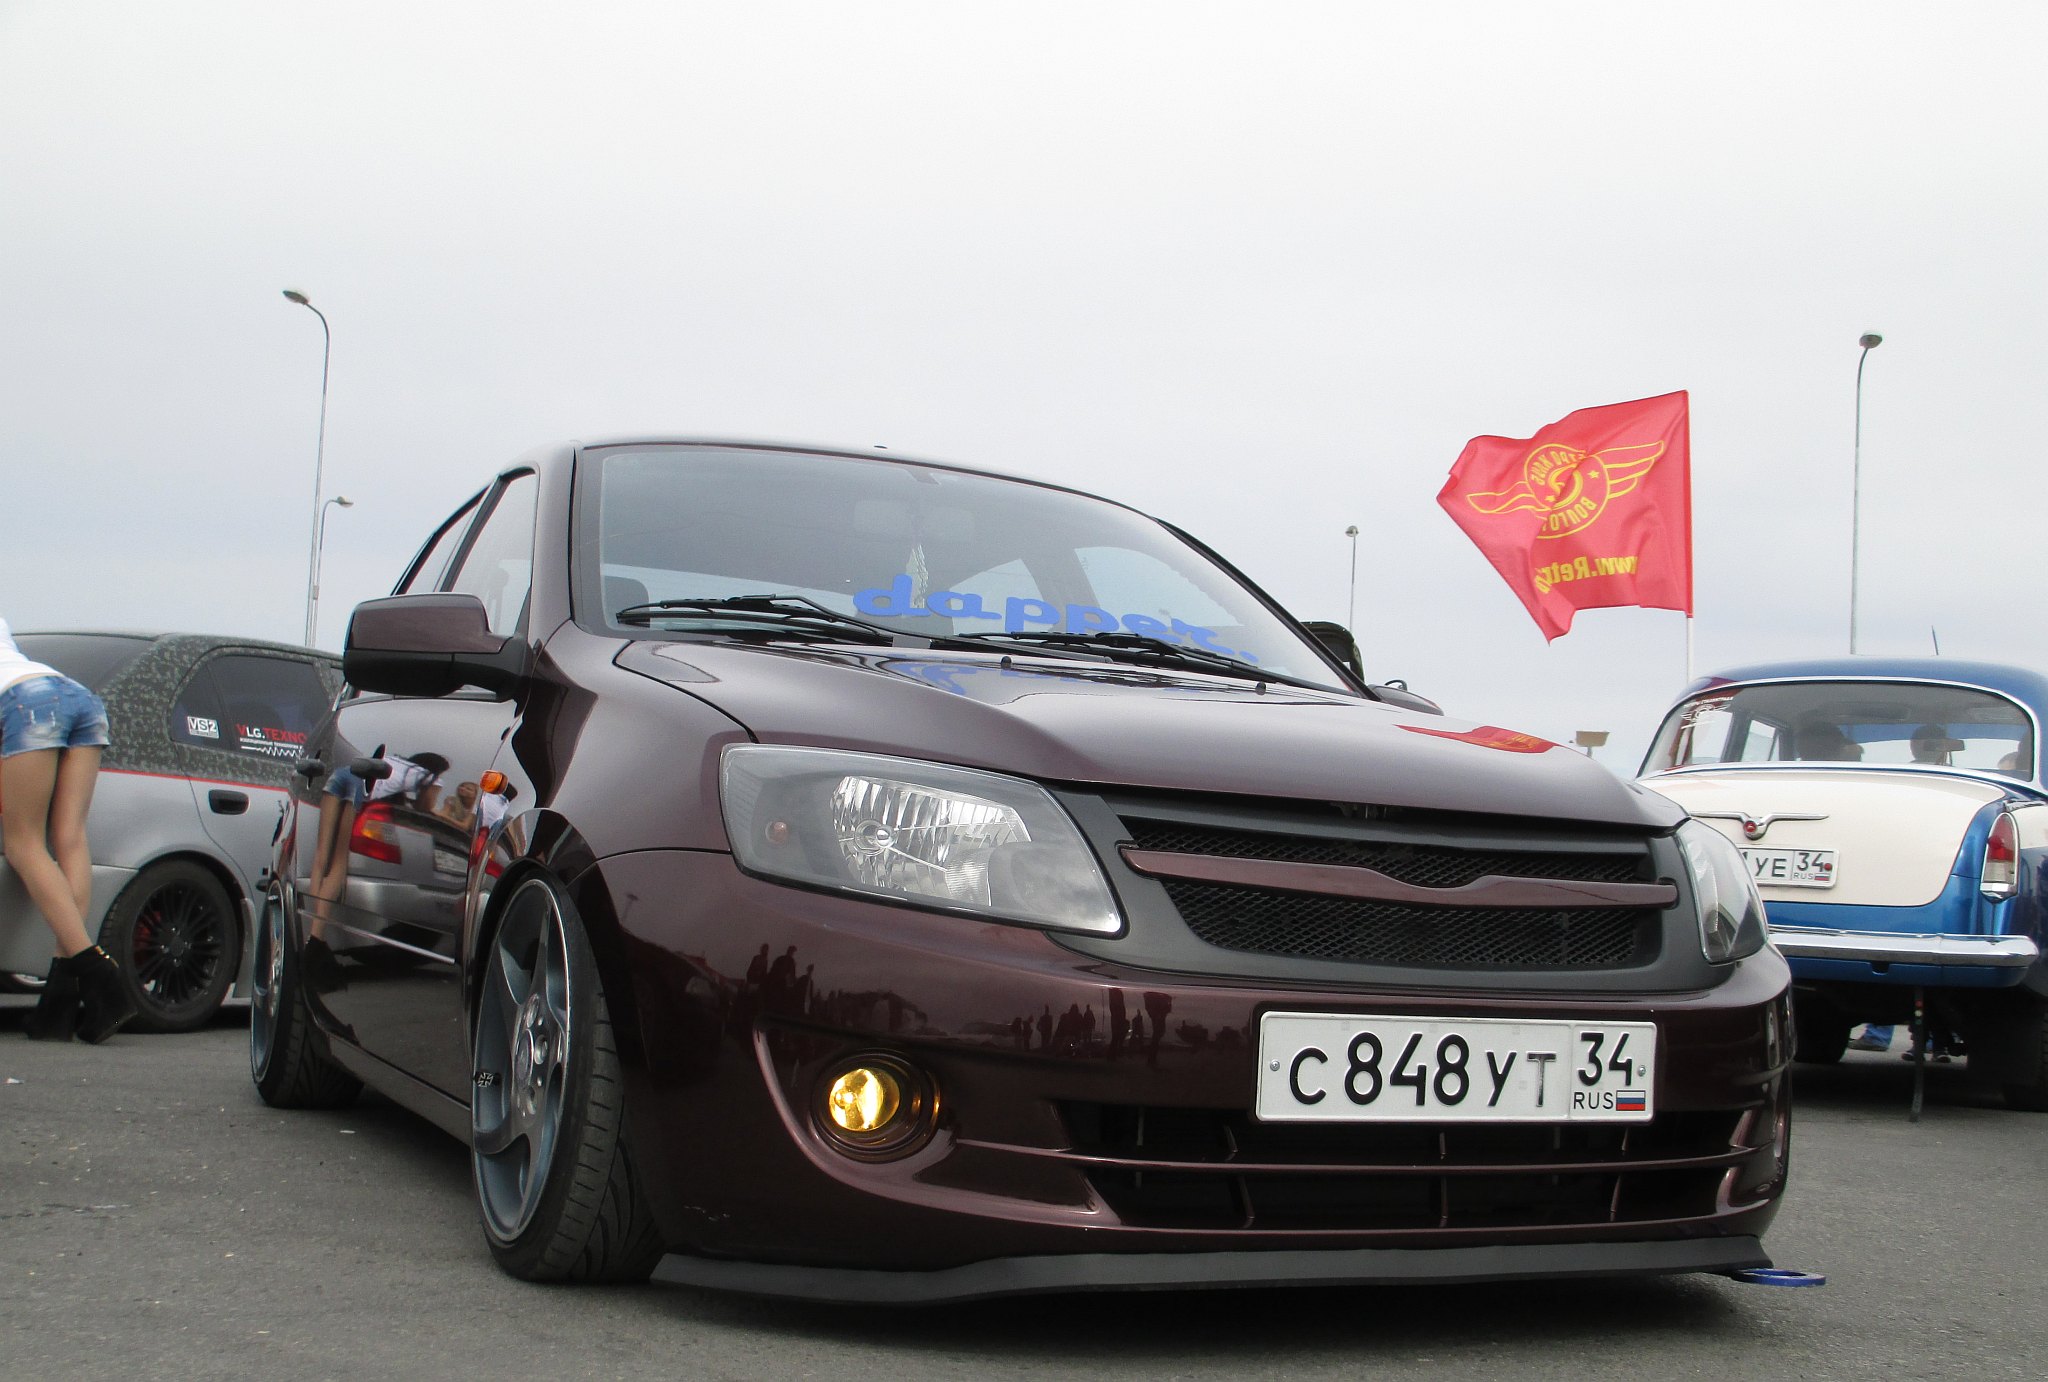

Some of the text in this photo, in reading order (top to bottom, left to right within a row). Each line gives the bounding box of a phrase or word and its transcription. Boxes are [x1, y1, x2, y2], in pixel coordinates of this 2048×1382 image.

[188, 717, 218, 733] VS2
[1797, 852, 1824, 873] 34
[1793, 872, 1814, 880] RUS
[1577, 1032, 1633, 1087] 34
[1573, 1090, 1614, 1110] RUS
